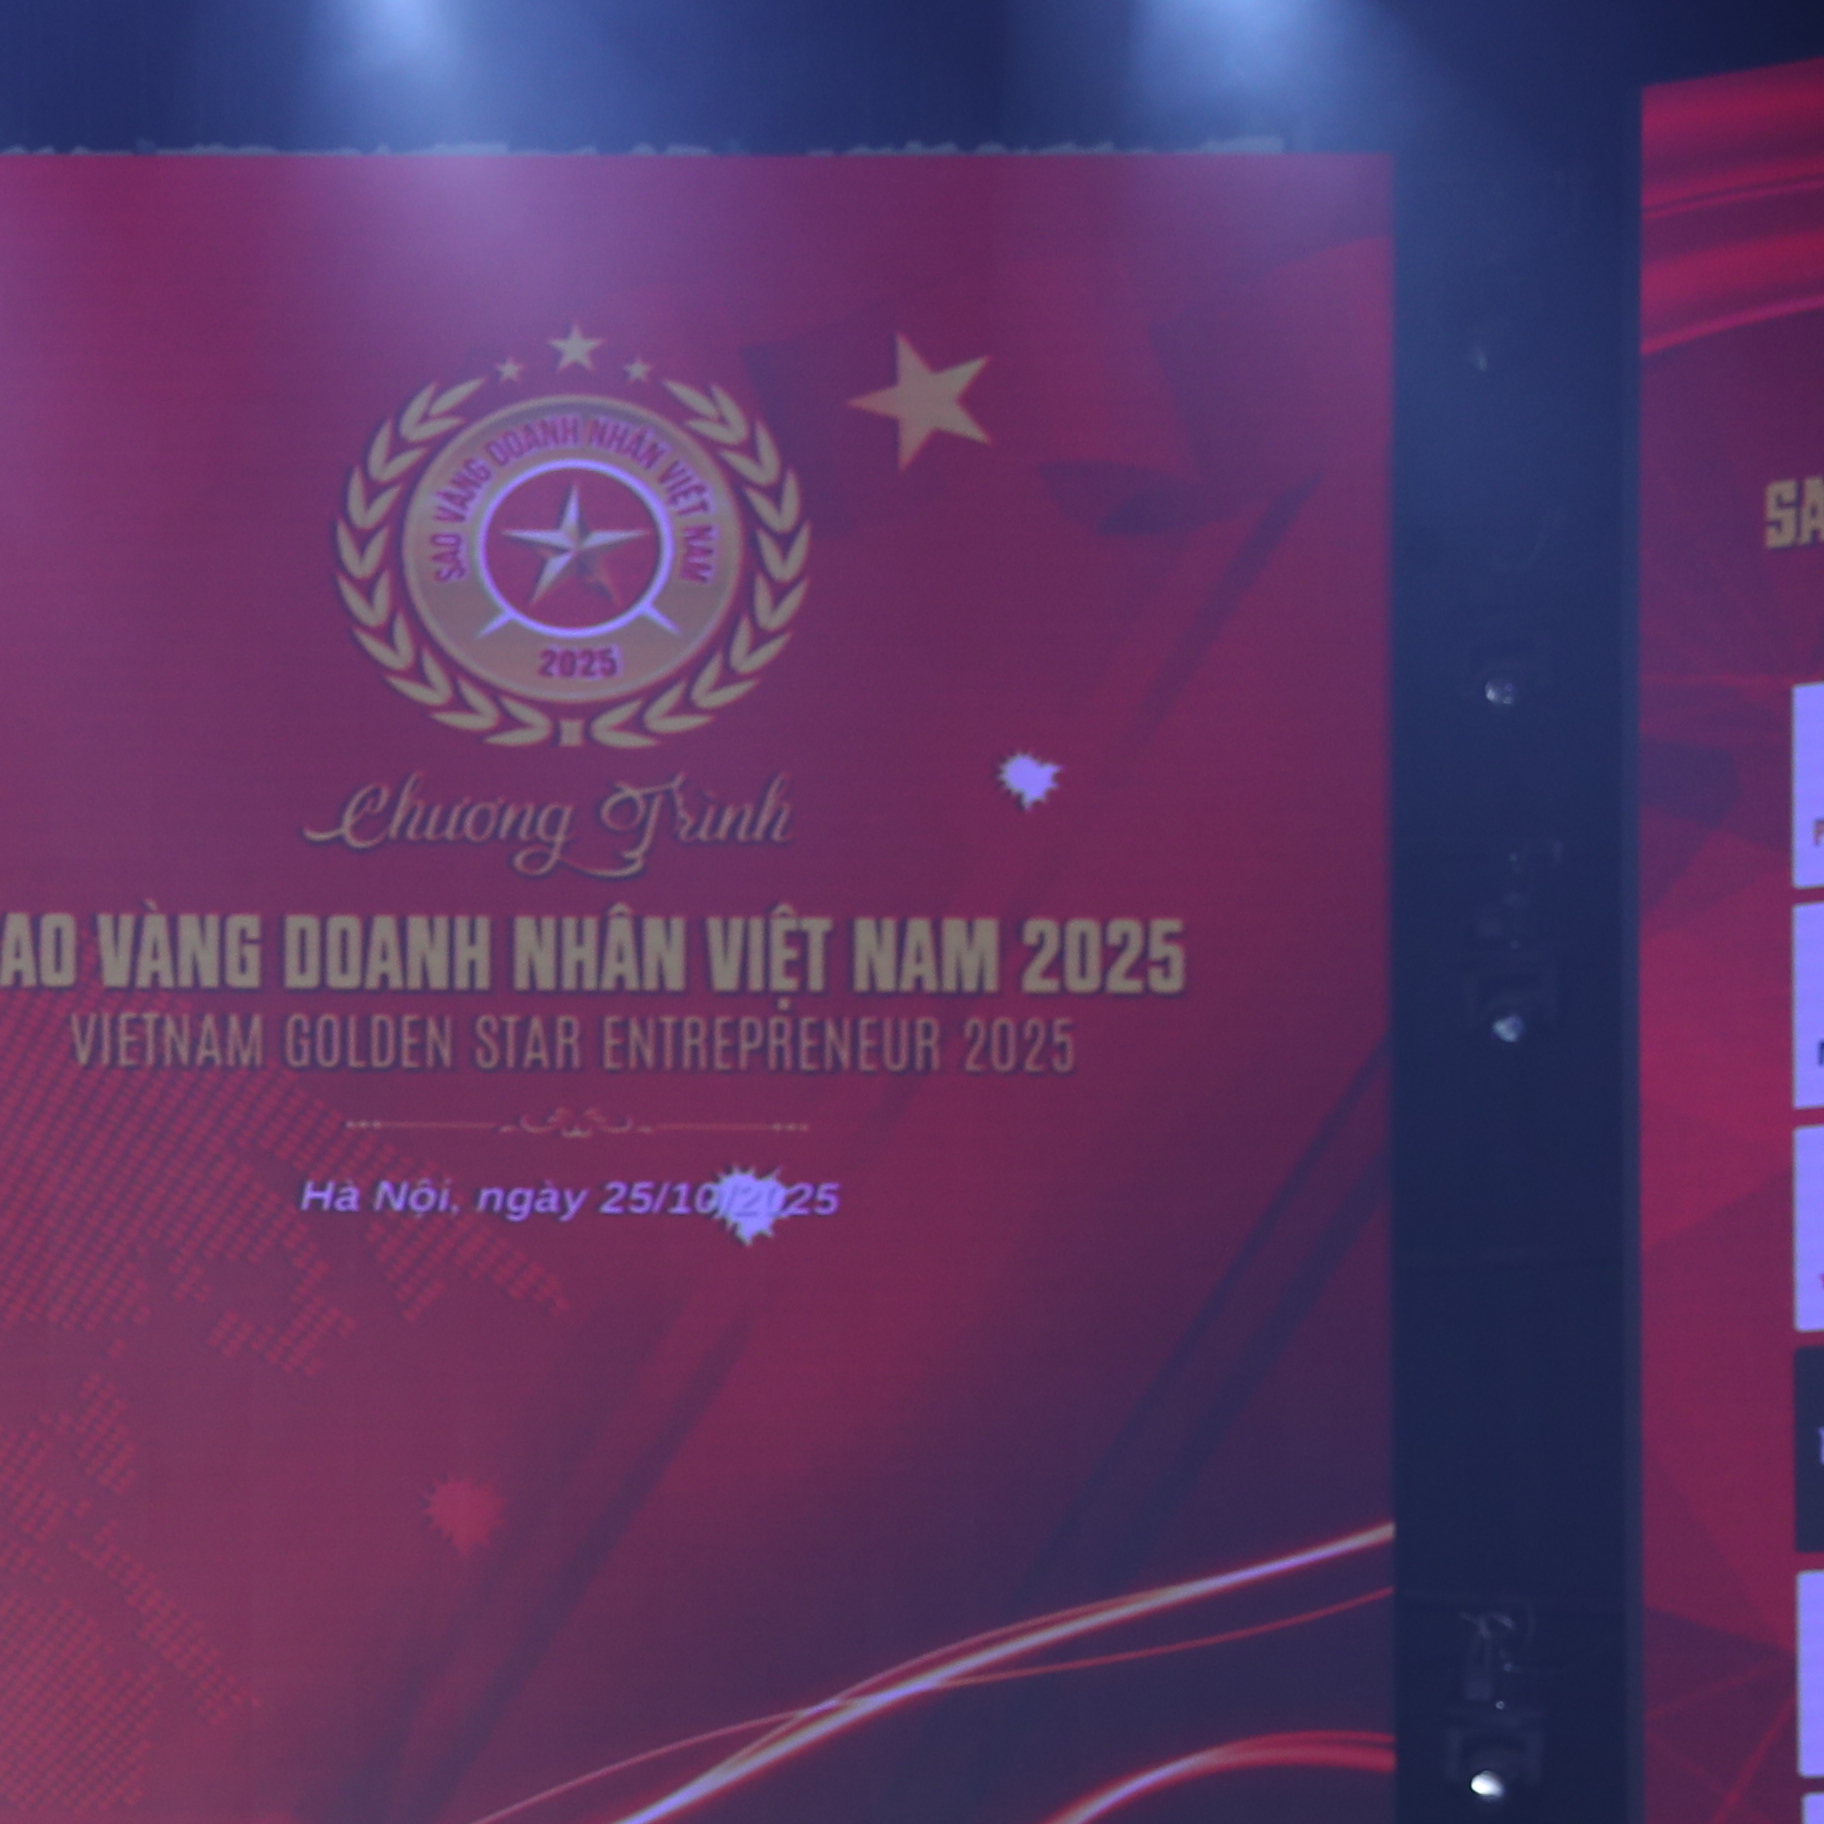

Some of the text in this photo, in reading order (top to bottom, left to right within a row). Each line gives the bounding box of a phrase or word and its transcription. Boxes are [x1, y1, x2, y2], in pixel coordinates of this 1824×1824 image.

[430, 532, 466, 584] SAO
[486, 413, 582, 467] DOANH
[681, 524, 719, 585] NAM
[538, 647, 622, 679] 2025
[303, 769, 793, 878] Chương Trình
[97, 899, 261, 989] VÀNG
[284, 915, 491, 990] DOANH
[512, 904, 685, 991] NHÂN
[707, 904, 833, 1010] VIỆT
[853, 916, 1000, 993] NAM
[1022, 917, 1184, 994] 2025
[72, 1012, 1075, 1074] VIETNAM GOLDEN STAR ENTREPRENEUR 2025
[300, 1179, 360, 1212] Hà
[374, 1179, 460, 1218] Nội,
[476, 1182, 587, 1221] ngày
